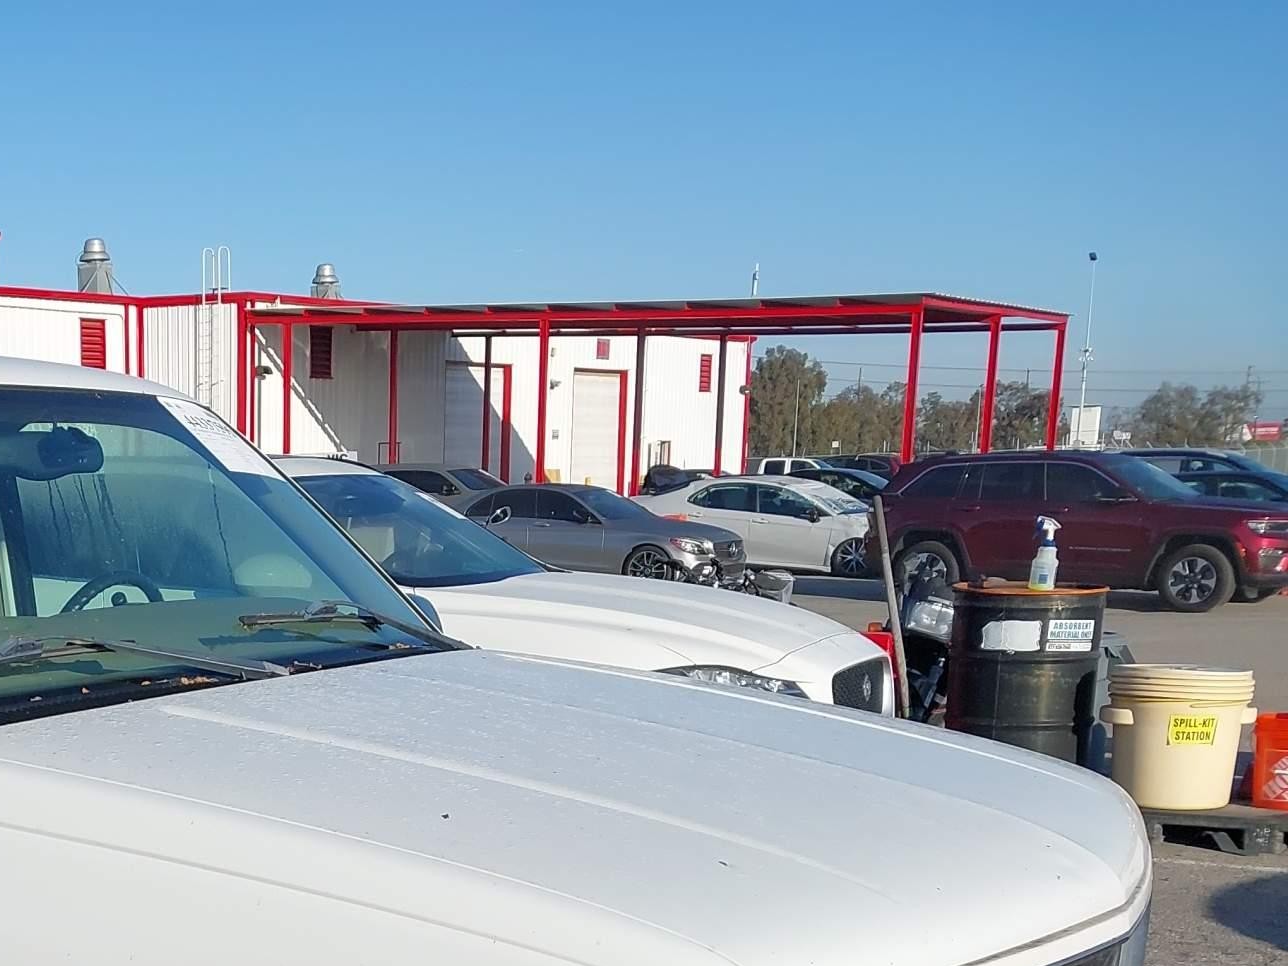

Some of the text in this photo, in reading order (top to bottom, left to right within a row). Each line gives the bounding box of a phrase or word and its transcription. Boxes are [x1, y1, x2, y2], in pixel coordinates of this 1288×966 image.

[1053, 621, 1092, 630] ABSORBENT
[1049, 630, 1079, 639] MATERIAL
[1173, 718, 1216, 728] SPILL-KIT
[1174, 731, 1211, 741] STATION
